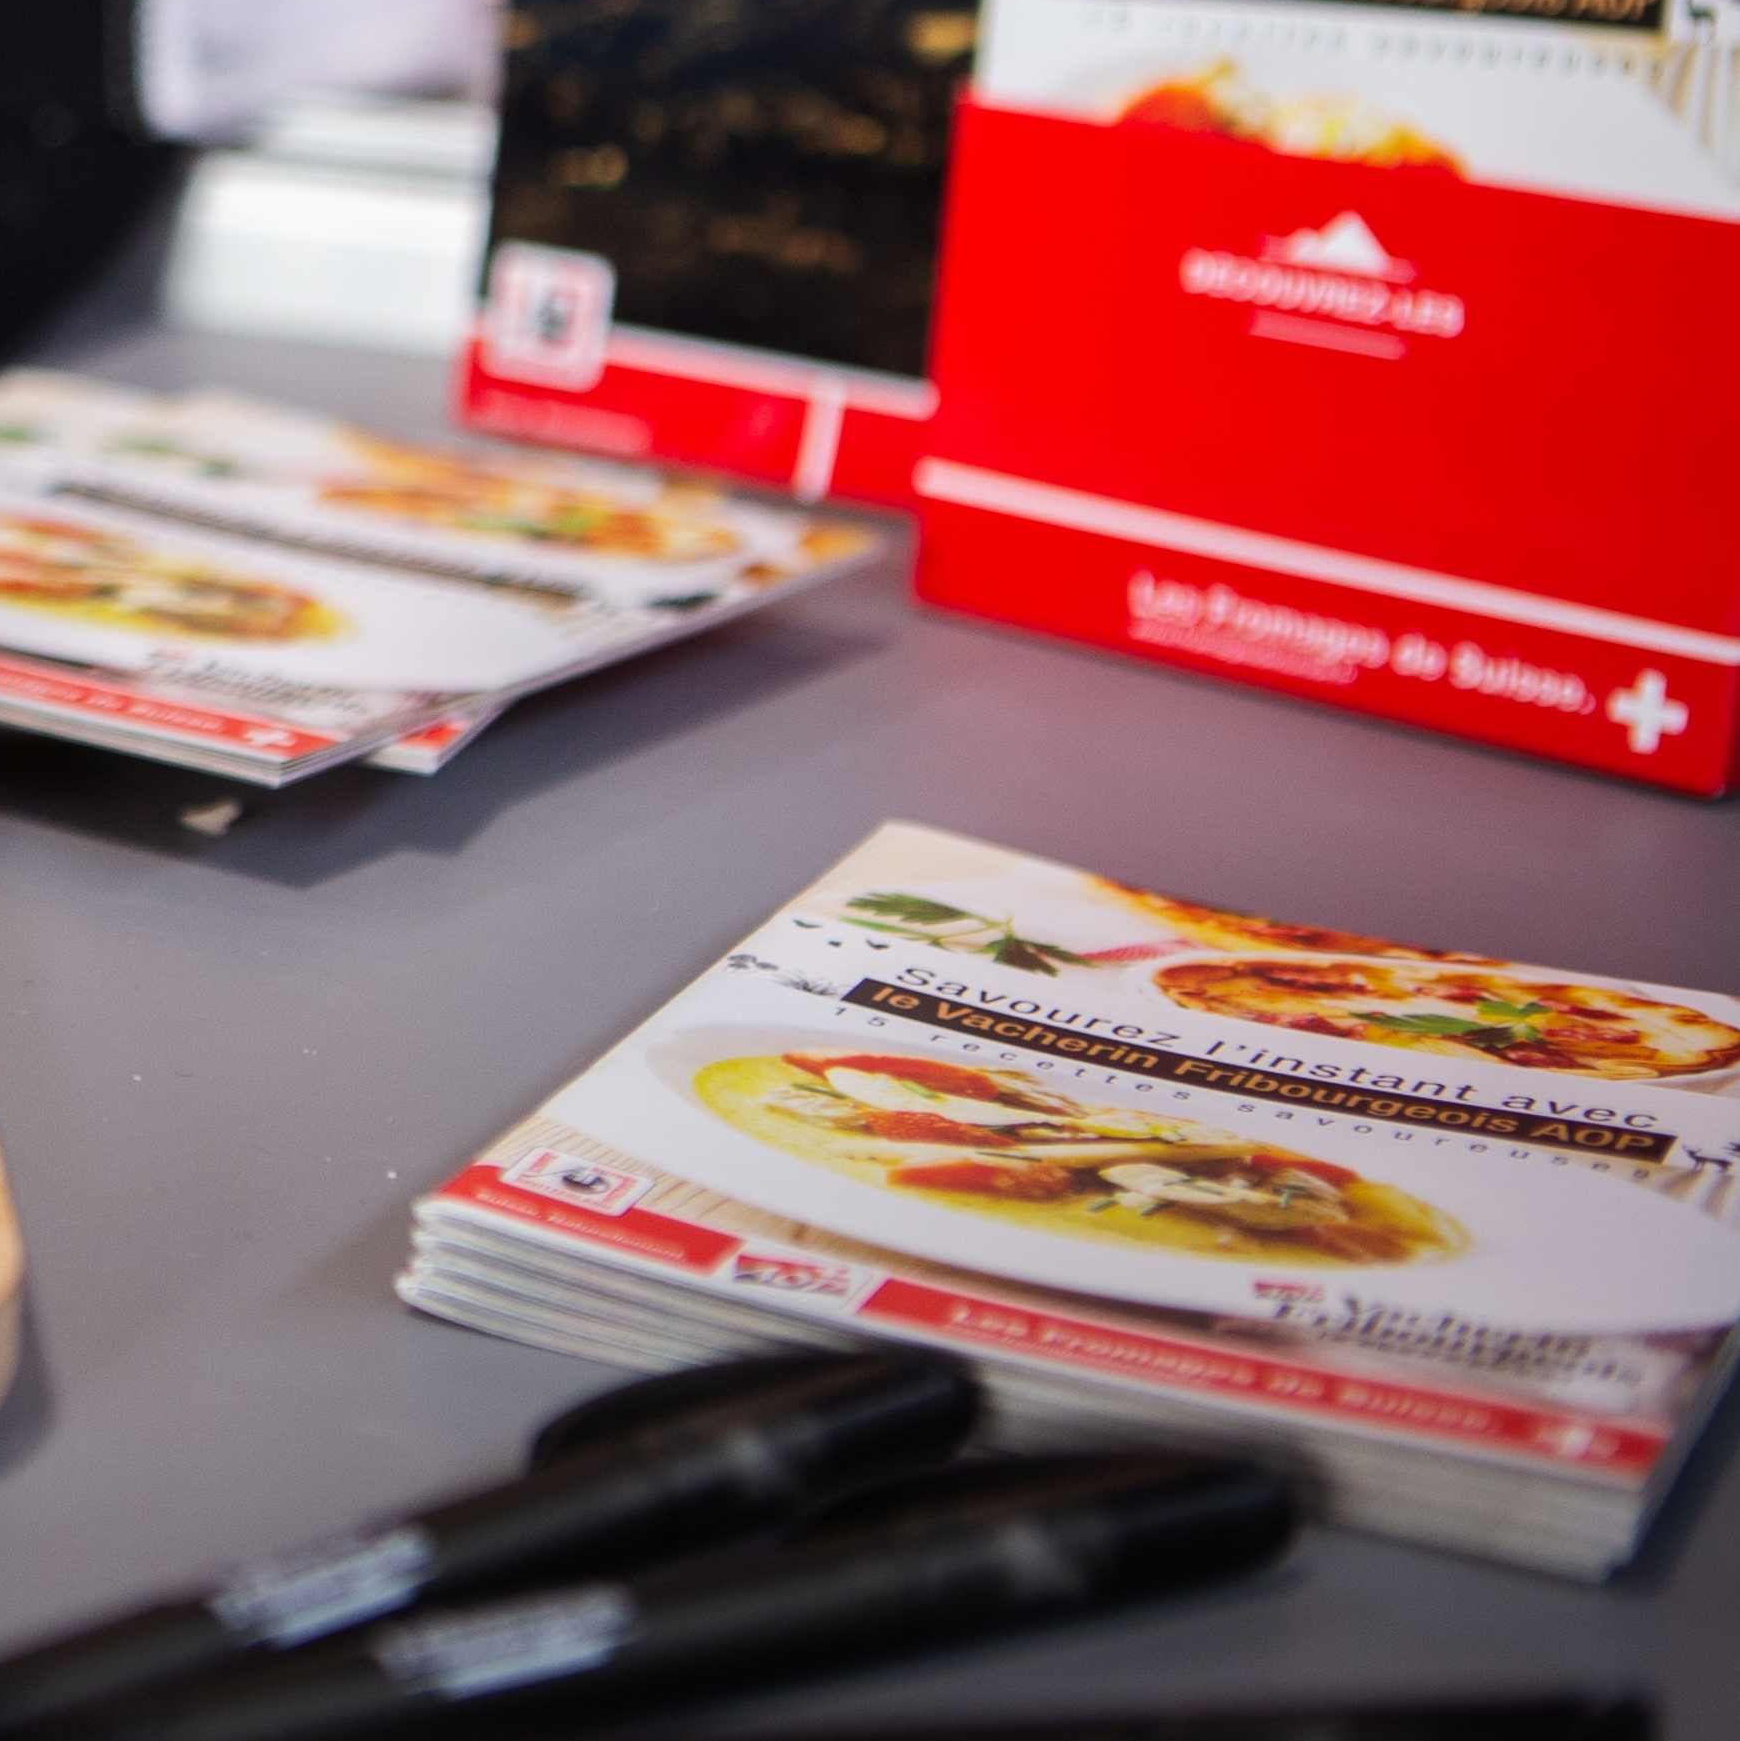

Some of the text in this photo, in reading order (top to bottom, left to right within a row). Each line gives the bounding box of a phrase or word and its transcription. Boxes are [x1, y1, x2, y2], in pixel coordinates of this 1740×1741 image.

[1127, 570, 1202, 628] Les
[1205, 582, 1392, 668] Fromages
[1391, 631, 1448, 681] de
[832, 1006, 1652, 1181] 15 recettes savoureuses
[870, 985, 1655, 1152] le Vacherin Fribourgeois AOP
[895, 967, 1662, 1130] Savourez l'instant avec
[950, 1303, 1028, 1336] Les
[1038, 1326, 1257, 1388] Fromages
